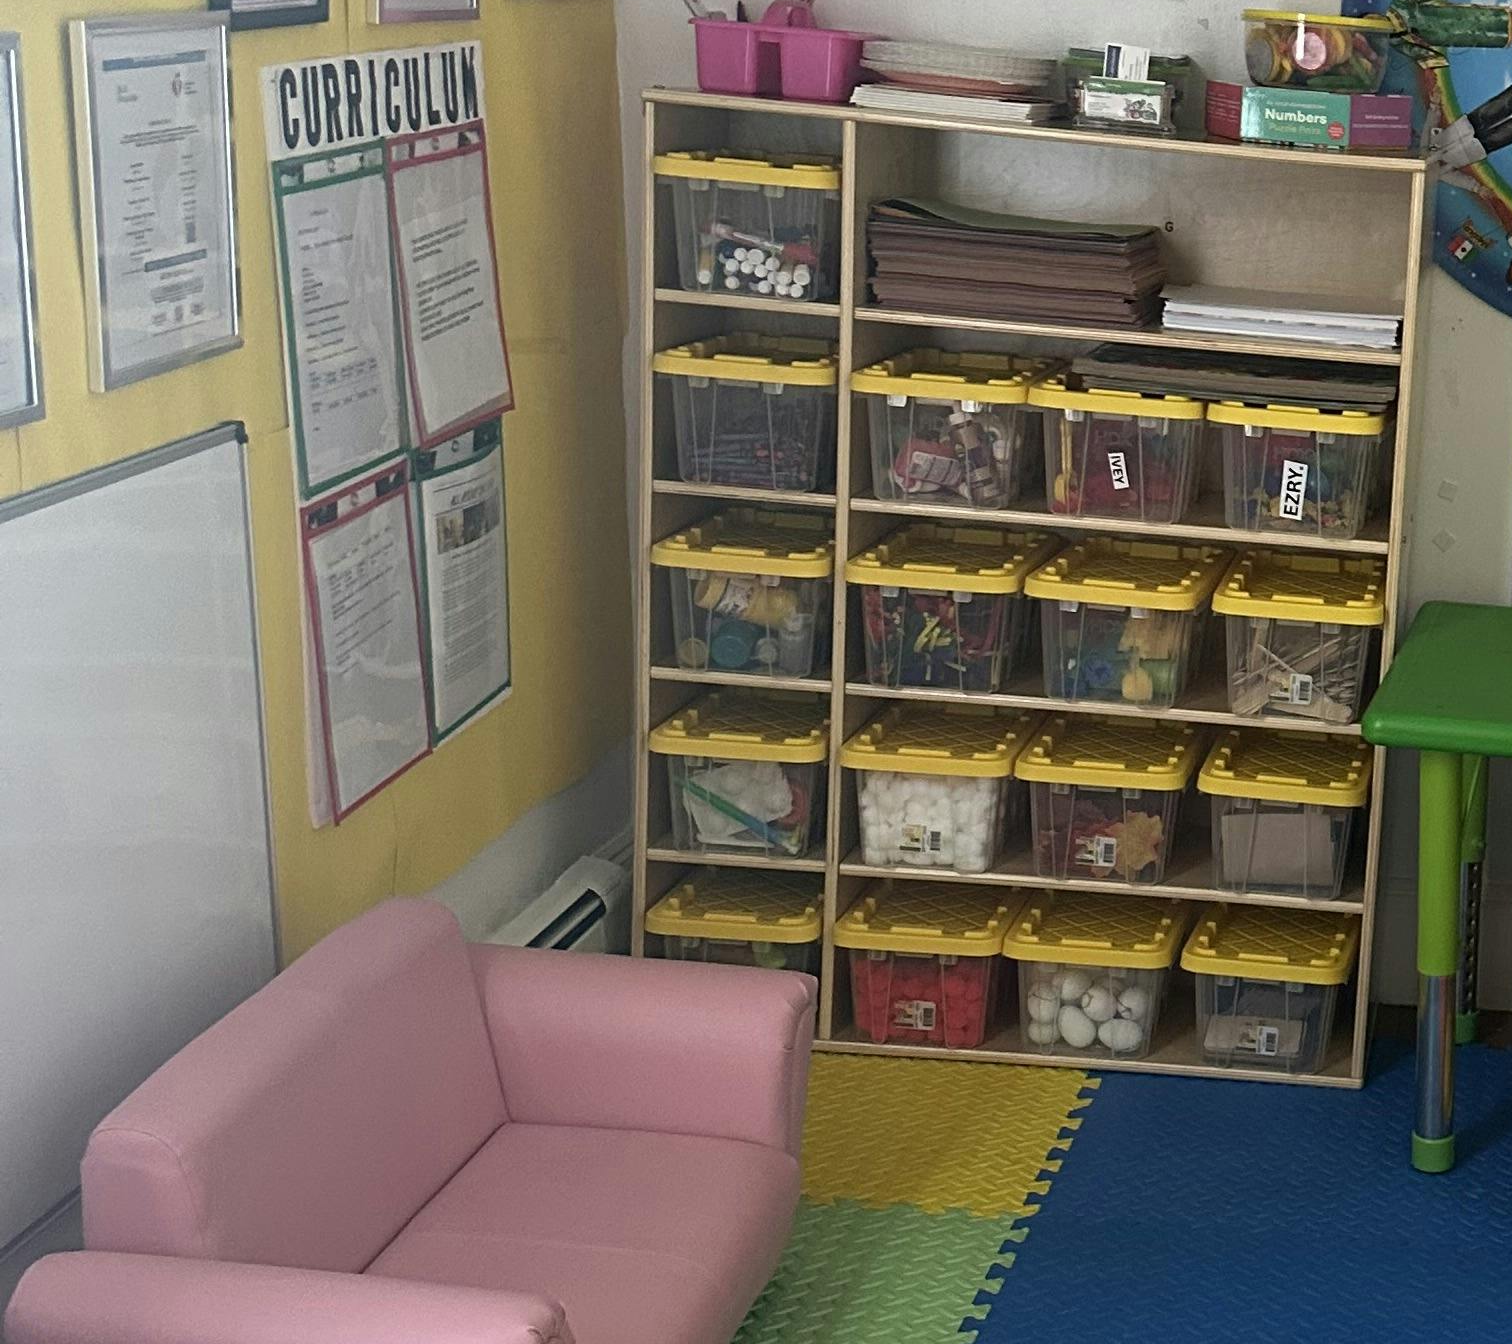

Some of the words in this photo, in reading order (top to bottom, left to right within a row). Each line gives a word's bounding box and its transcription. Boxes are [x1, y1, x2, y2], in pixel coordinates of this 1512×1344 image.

[279, 45, 479, 150] CURRICULUM
[1264, 108, 1328, 125] Numbers
[1111, 455, 1125, 484] IVEY
